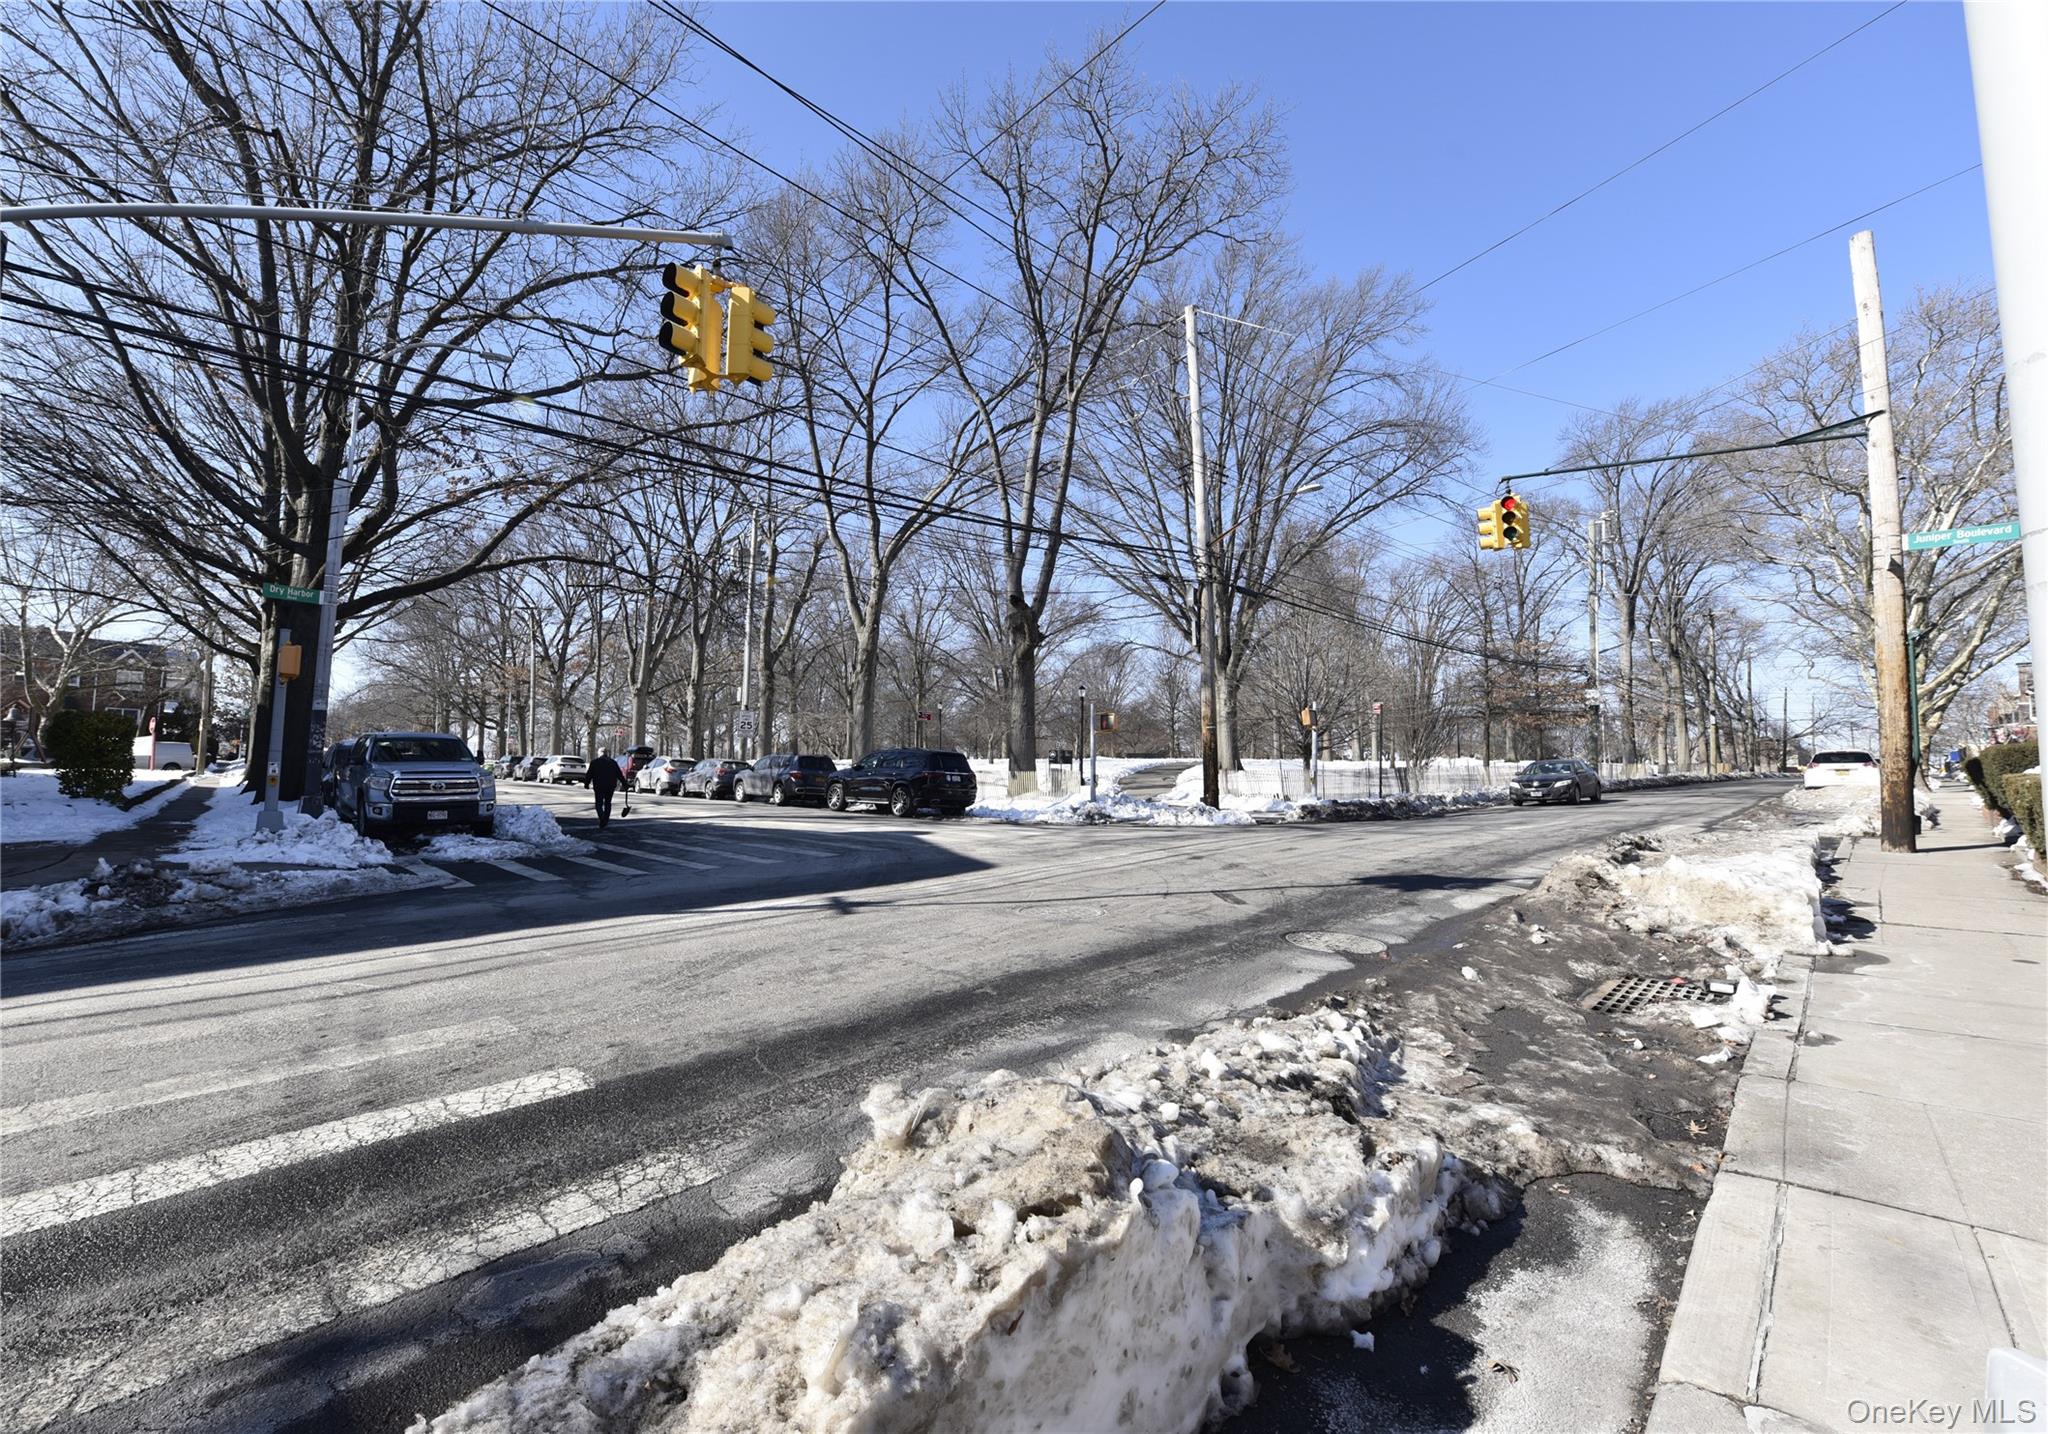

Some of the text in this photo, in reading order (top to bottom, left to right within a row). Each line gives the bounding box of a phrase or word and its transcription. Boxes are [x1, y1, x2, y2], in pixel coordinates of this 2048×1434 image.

[1914, 532, 1953, 543] Juniper
[1956, 524, 2012, 539] Boulevard
[269, 584, 285, 596] Dry
[287, 587, 314, 598] Harbor
[740, 721, 753, 730] 25
